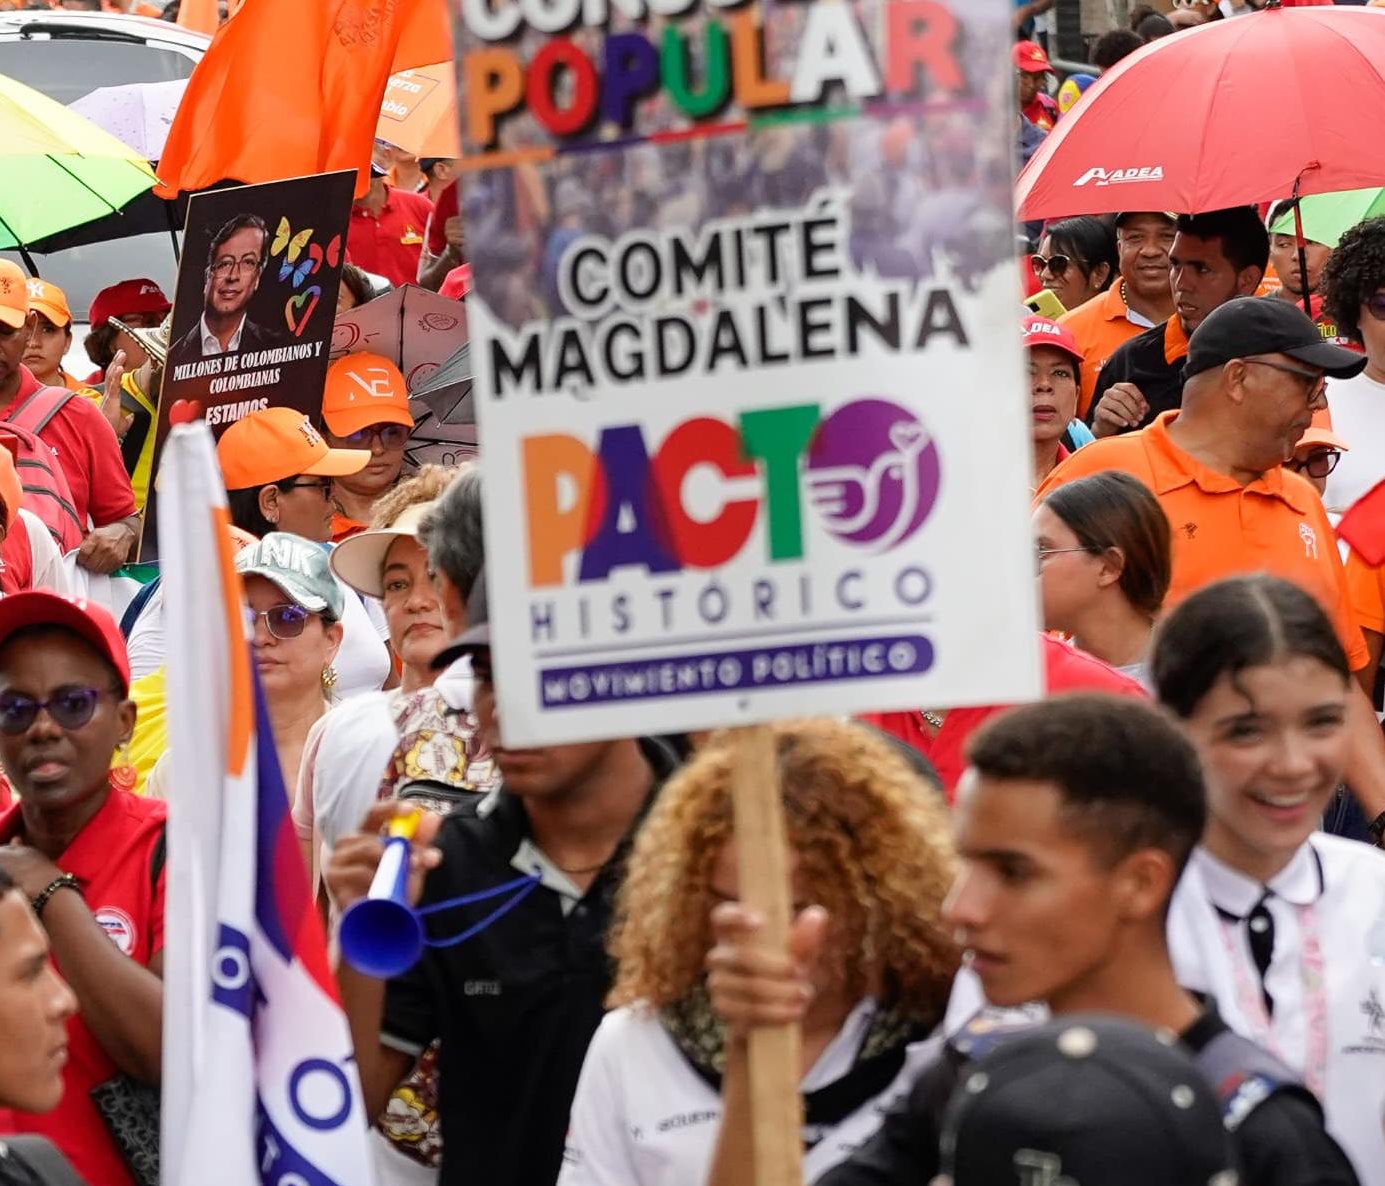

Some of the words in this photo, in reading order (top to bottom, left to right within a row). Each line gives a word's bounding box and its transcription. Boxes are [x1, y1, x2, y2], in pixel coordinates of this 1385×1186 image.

[460, 0, 968, 145] POPULAR
[569, 199, 841, 307] COMITÉ
[490, 289, 970, 398] MAGDALENA
[1030, 321, 1062, 336] DEA
[173, 359, 222, 382] MILLONES
[223, 354, 239, 373] DE
[240, 343, 313, 370] COLOMBIANOS
[313, 341, 323, 357] Y
[208, 367, 281, 395] COLOMBIANAS
[235, 540, 319, 577] INK
[529, 564, 934, 643] HISTÓRICO
[543, 656, 743, 704] MOVIMIENTO
[751, 639, 919, 685] POLÍTICO
